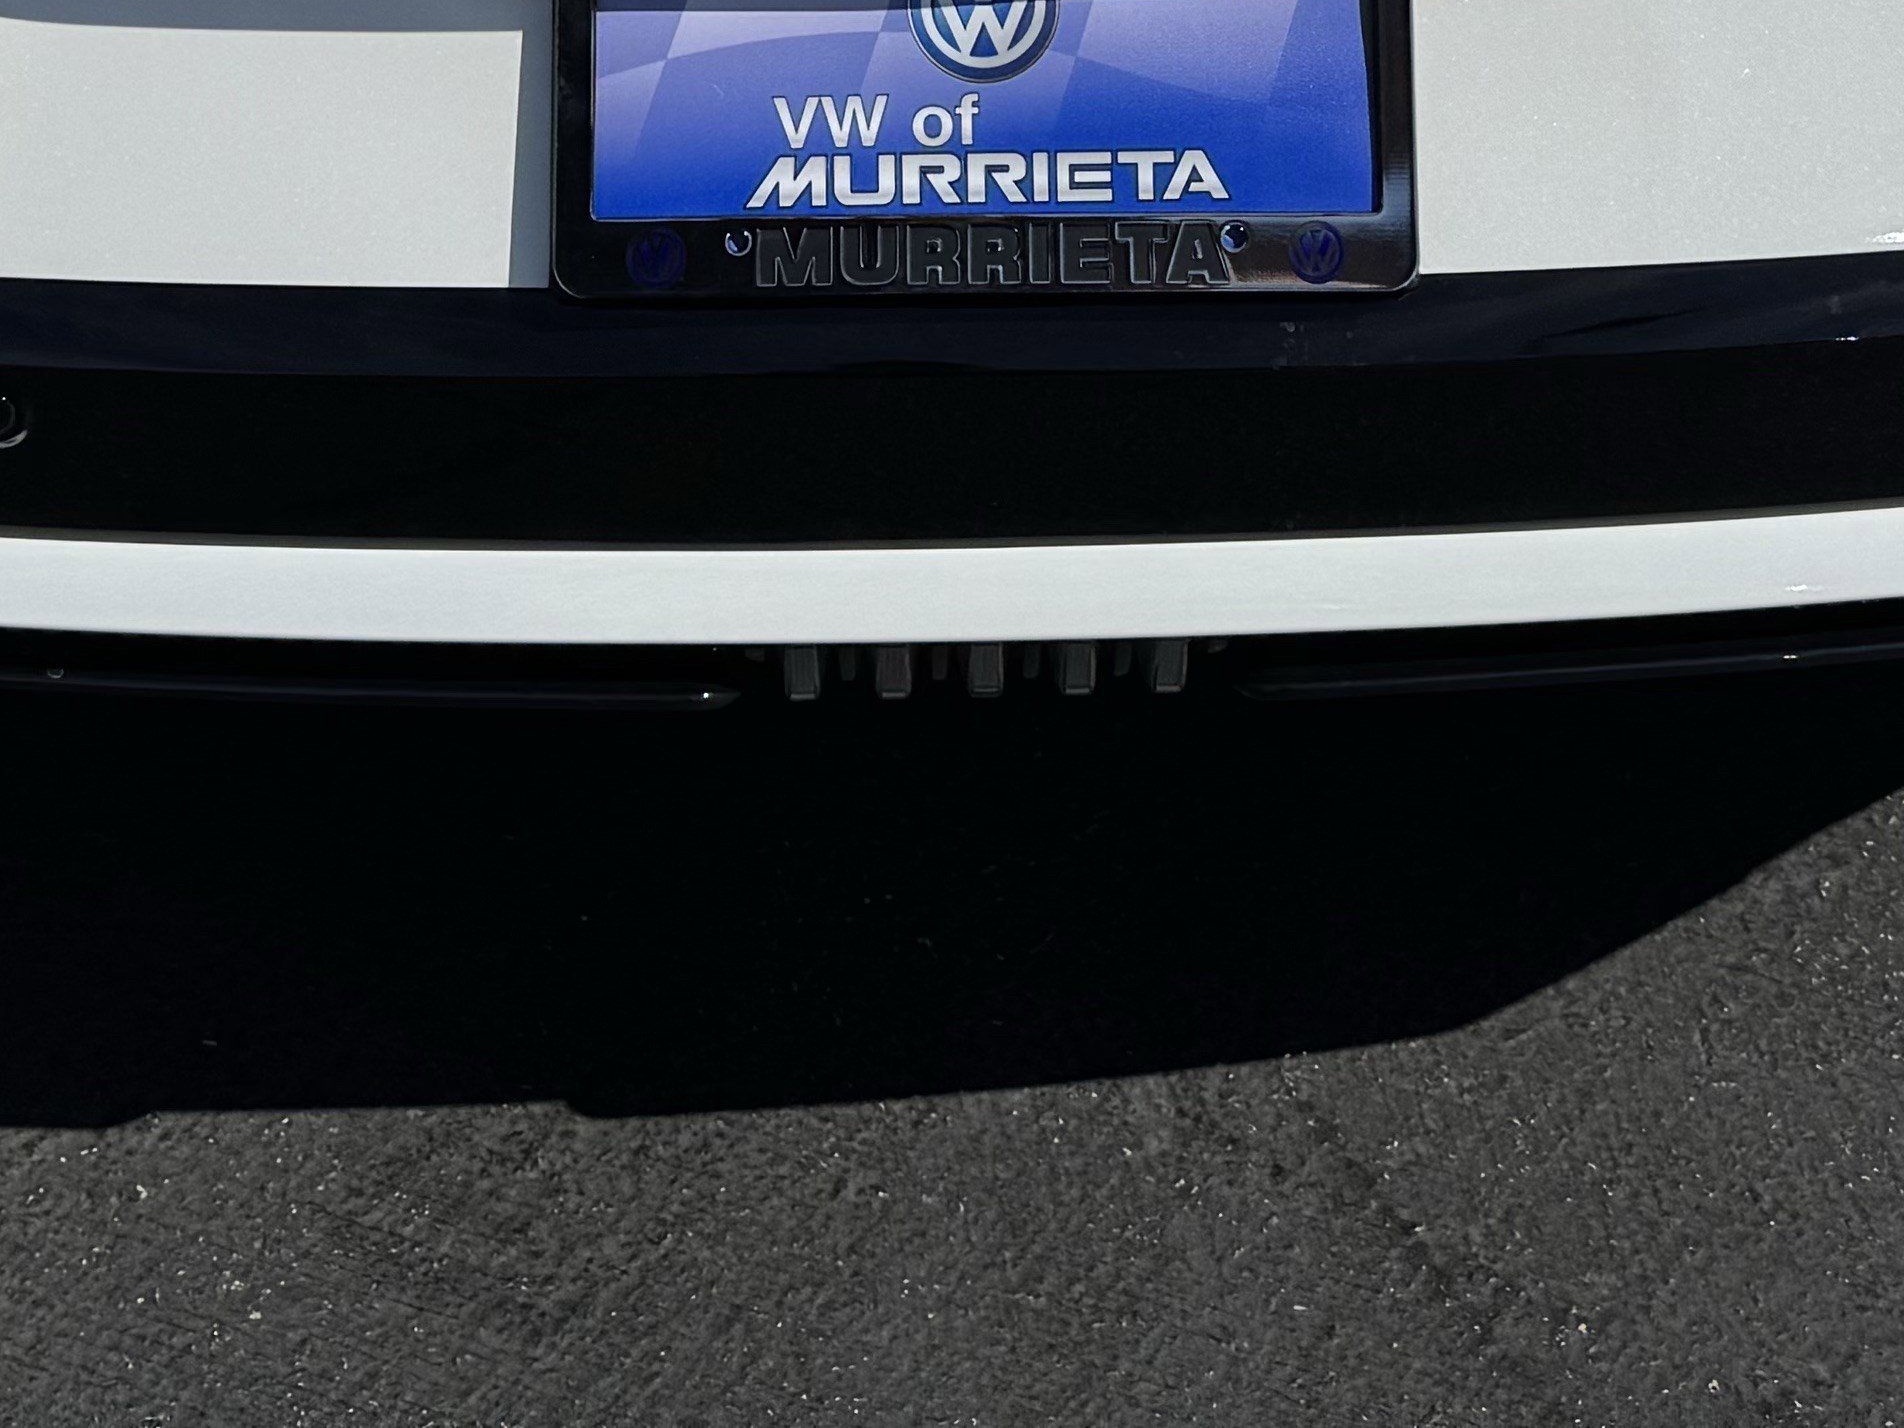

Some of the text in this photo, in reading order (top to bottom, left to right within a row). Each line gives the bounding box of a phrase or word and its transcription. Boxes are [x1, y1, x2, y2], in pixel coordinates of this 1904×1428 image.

[772, 92, 981, 150] VW of
[745, 149, 1232, 209] MURRIETA
[754, 219, 1232, 287] MURRIETA
